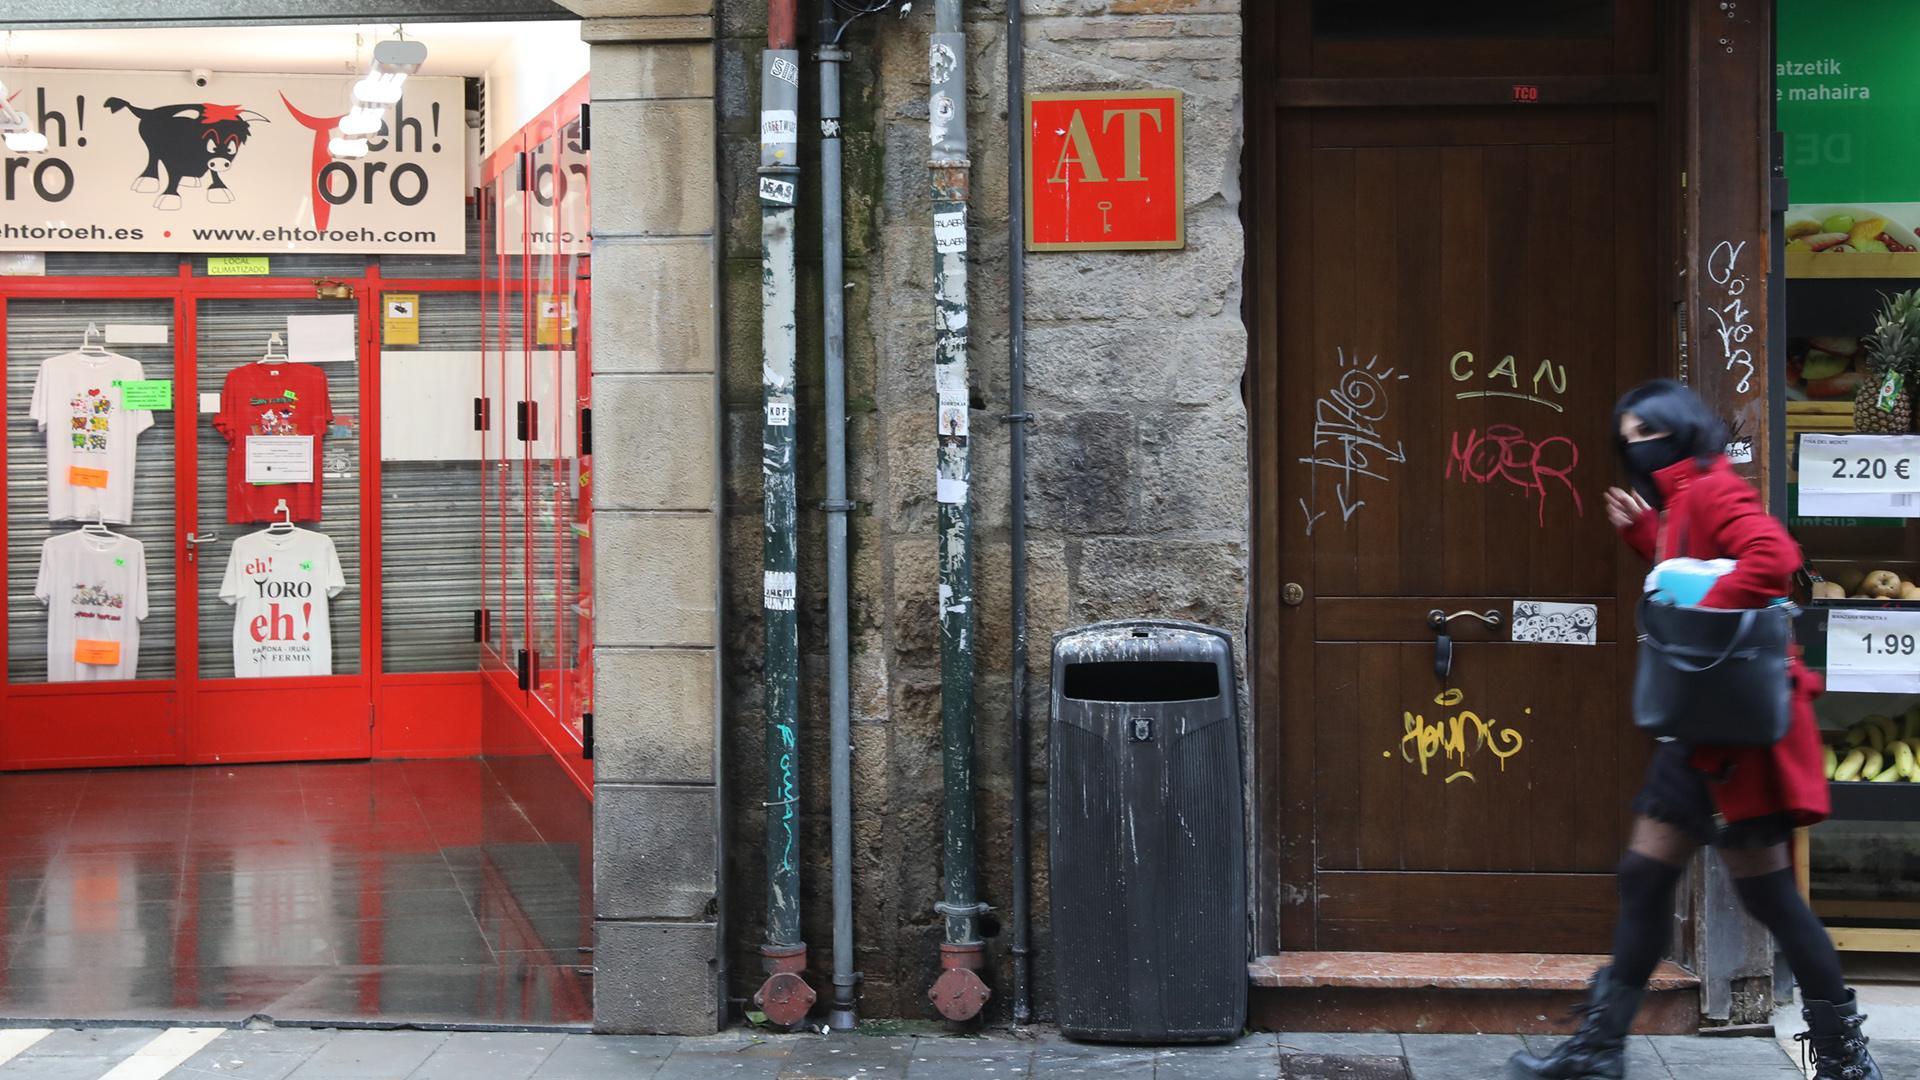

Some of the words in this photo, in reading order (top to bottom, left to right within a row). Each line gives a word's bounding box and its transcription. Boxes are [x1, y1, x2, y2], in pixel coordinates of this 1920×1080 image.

[1788, 84, 1870, 101] mahaira
[37, 87, 87, 147] h!
[1047, 109, 1162, 183] AT
[0, 224, 144, 240] htoroeh.es
[193, 227, 436, 243] www.ehtoroeh.com
[211, 265, 266, 275] CLIMATIZADO
[1450, 351, 1566, 394] CAN
[1832, 457, 1887, 479] 2.20
[1894, 458, 1910, 480] €
[246, 556, 273, 575] eh!
[254, 578, 312, 598] TORO
[250, 602, 312, 643] eh!
[1862, 633, 1915, 655] 1.99
[272, 654, 312, 662] FERMIN
